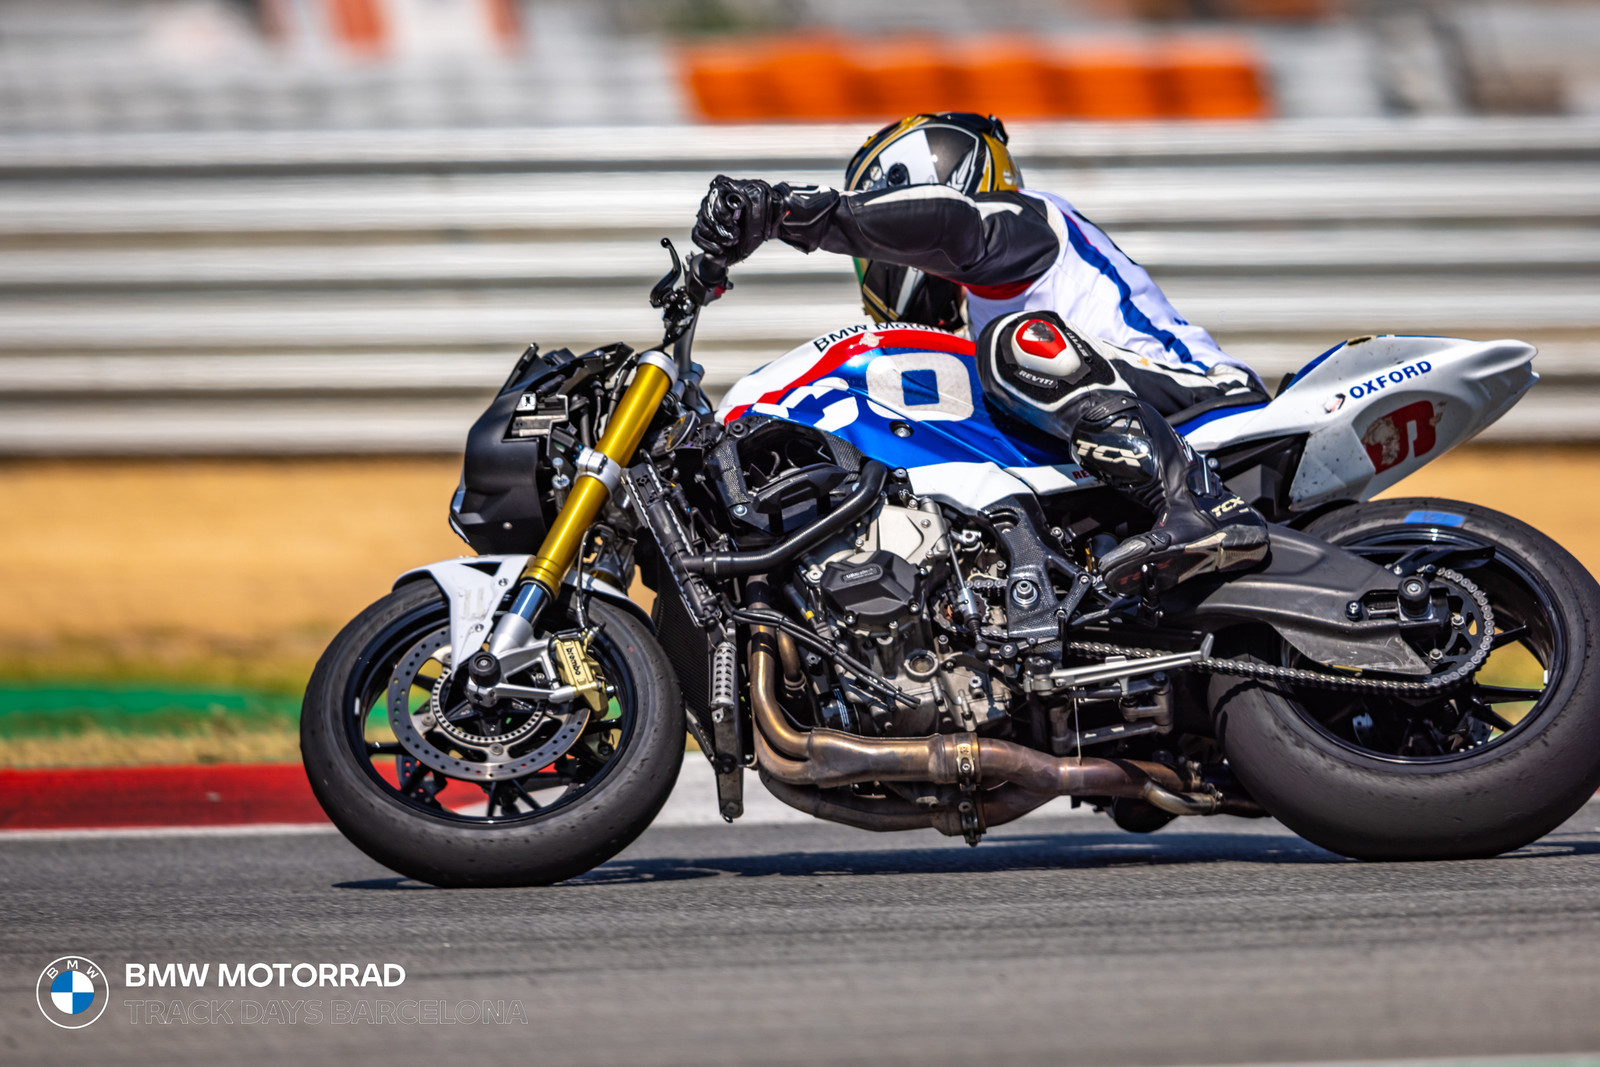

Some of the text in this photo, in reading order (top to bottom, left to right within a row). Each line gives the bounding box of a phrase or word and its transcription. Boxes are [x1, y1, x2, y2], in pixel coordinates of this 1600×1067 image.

[814, 322, 868, 353] BMW
[1349, 360, 1432, 399] OXFORD
[1075, 439, 1149, 468] TCX
[1071, 469, 1093, 480] RE
[1211, 496, 1245, 518] TCX
[565, 647, 582, 676] brembo
